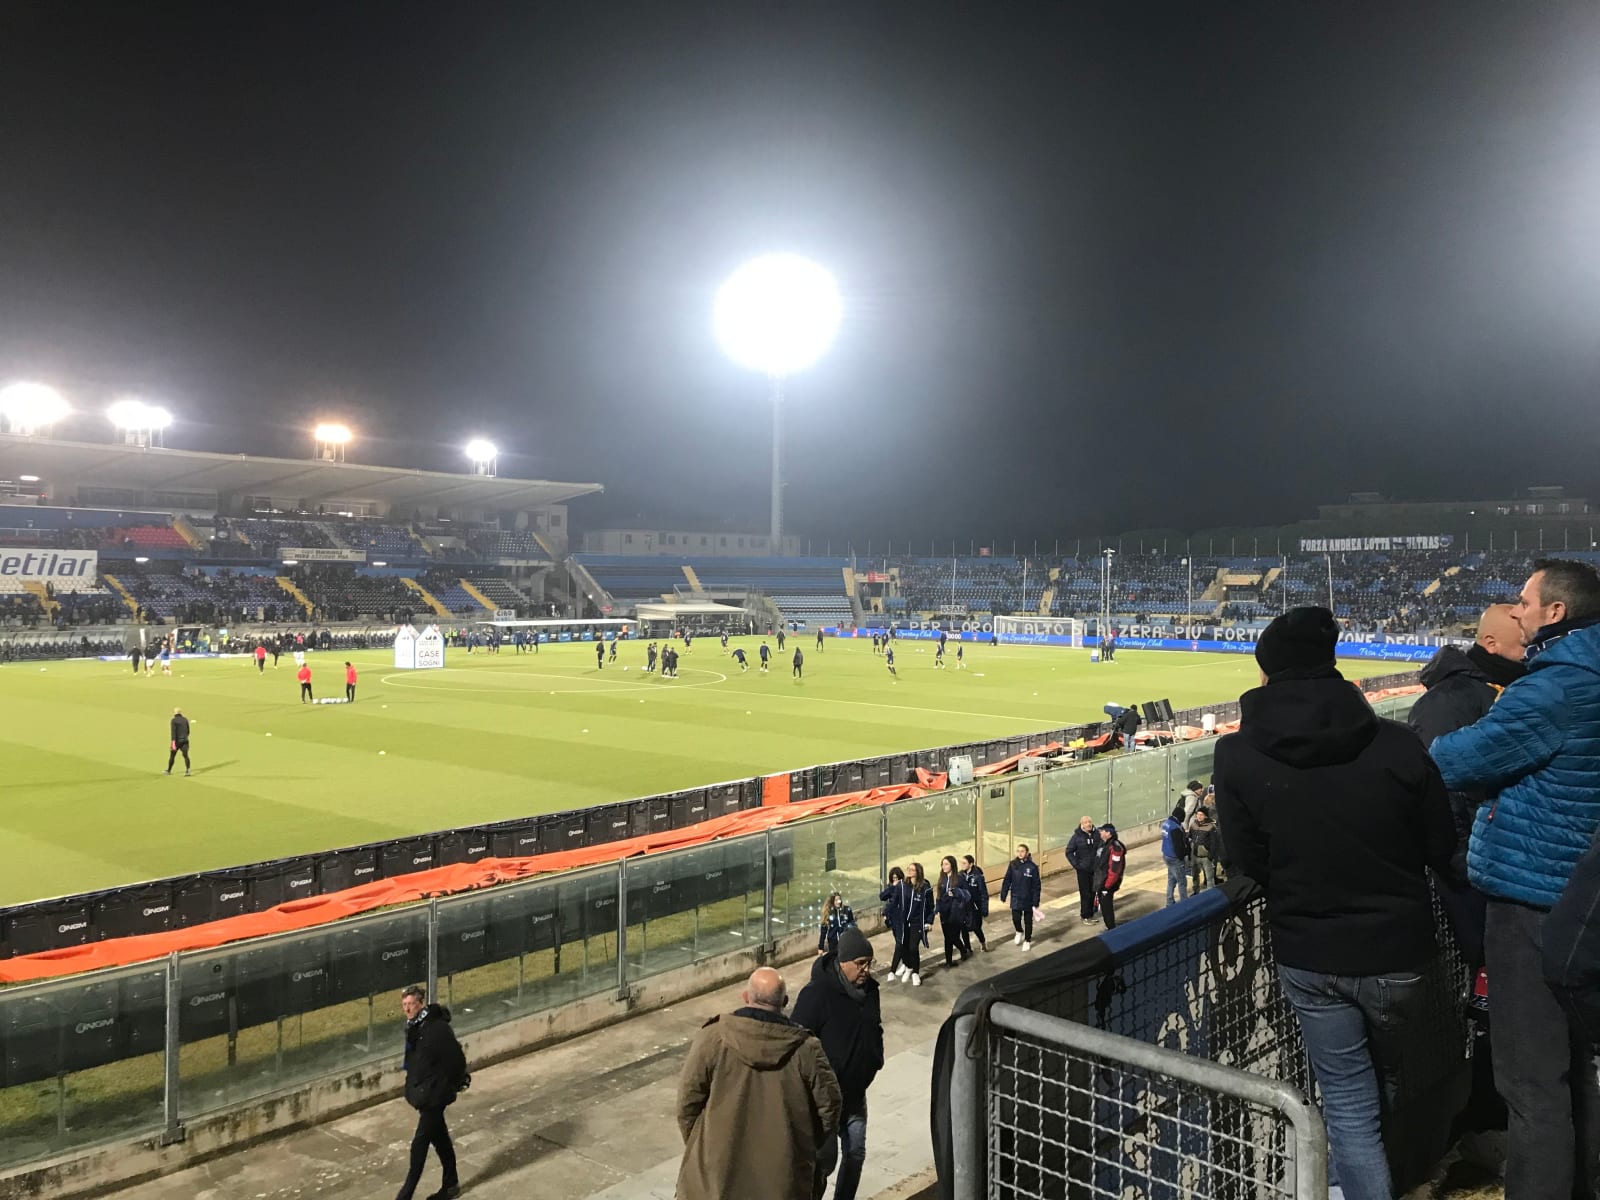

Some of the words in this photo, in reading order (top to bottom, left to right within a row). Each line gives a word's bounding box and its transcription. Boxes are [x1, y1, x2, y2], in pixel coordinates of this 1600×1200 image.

[1300, 539, 1327, 551] FORZA
[1329, 538, 1362, 551] ANDREA
[1364, 537, 1390, 550] LOTTA
[0, 553, 93, 577] etilar
[910, 621, 941, 631] PER
[950, 621, 993, 633] LORO
[1001, 622, 1018, 634] IN
[1024, 623, 1064, 636] ALTO
[1119, 639, 1145, 649] Sporting
[1146, 639, 1163, 647] Club
[418, 650, 440, 658] CASE
[1378, 648, 1412, 661] Sporting
[1413, 649, 1434, 659] Club
